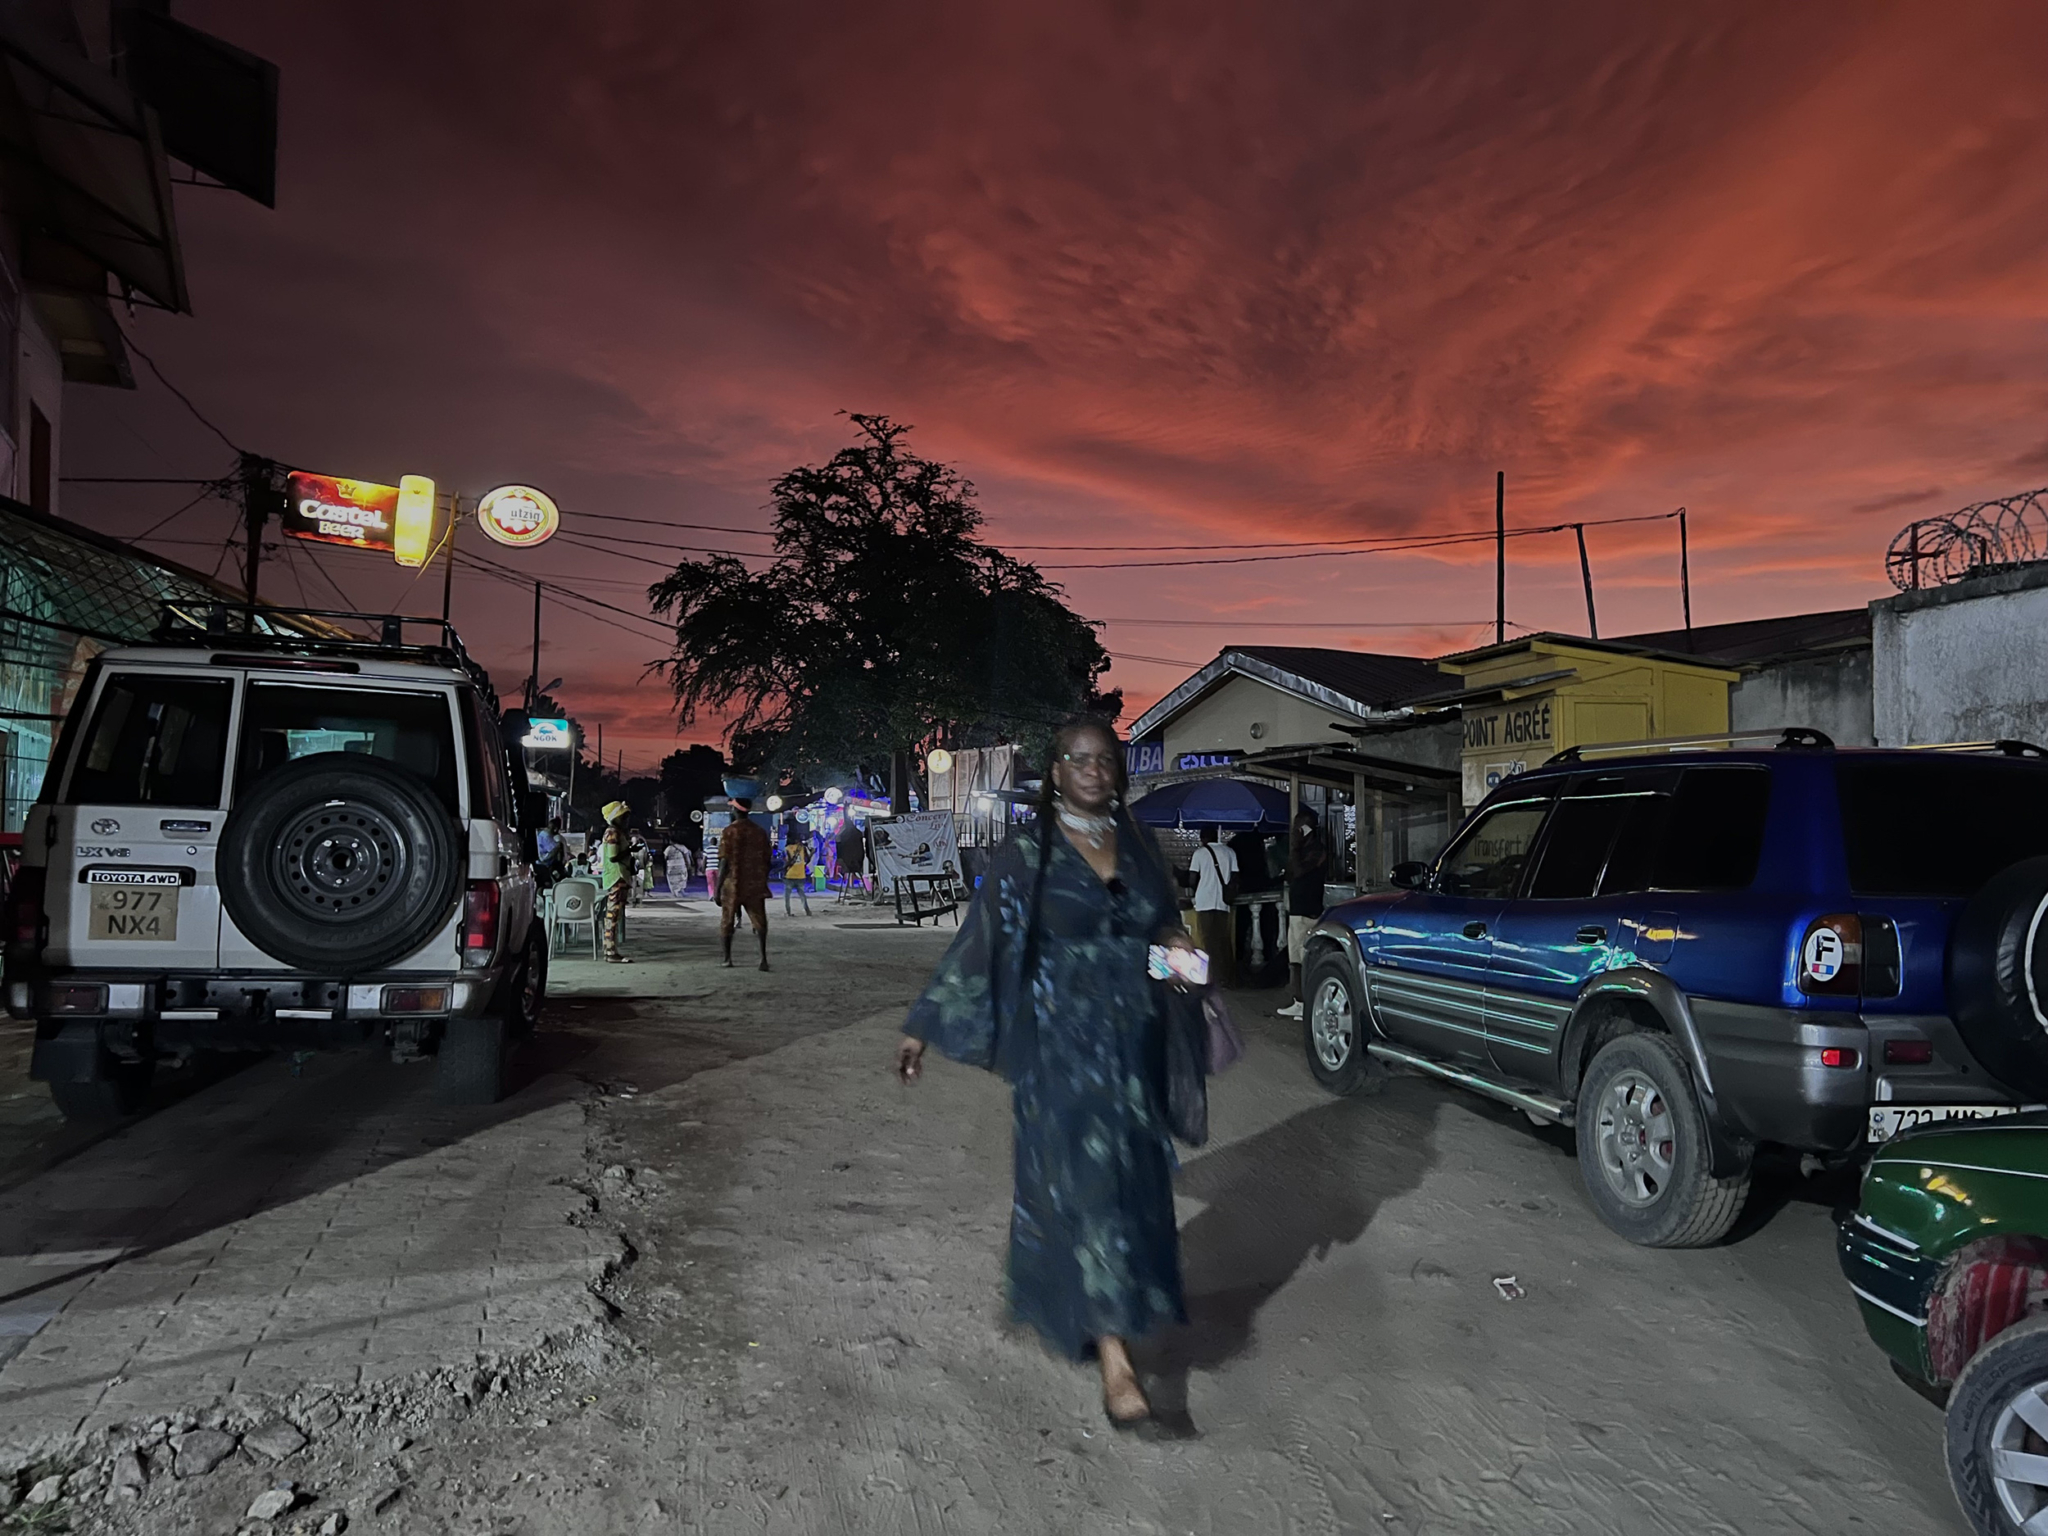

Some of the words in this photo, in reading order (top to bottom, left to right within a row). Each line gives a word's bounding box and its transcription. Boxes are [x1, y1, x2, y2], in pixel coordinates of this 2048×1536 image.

[1462, 715, 1499, 749] POINT
[1504, 703, 1551, 744] AGRÉÉ
[906, 812, 948, 823] Concert
[76, 846, 103, 857] LX
[1473, 834, 1522, 857] Transfert
[94, 873, 143, 883] TOYOTA
[146, 874, 178, 884] 4WD
[113, 890, 162, 911] 977
[108, 914, 161, 936] NX4
[1815, 935, 1836, 962] F
